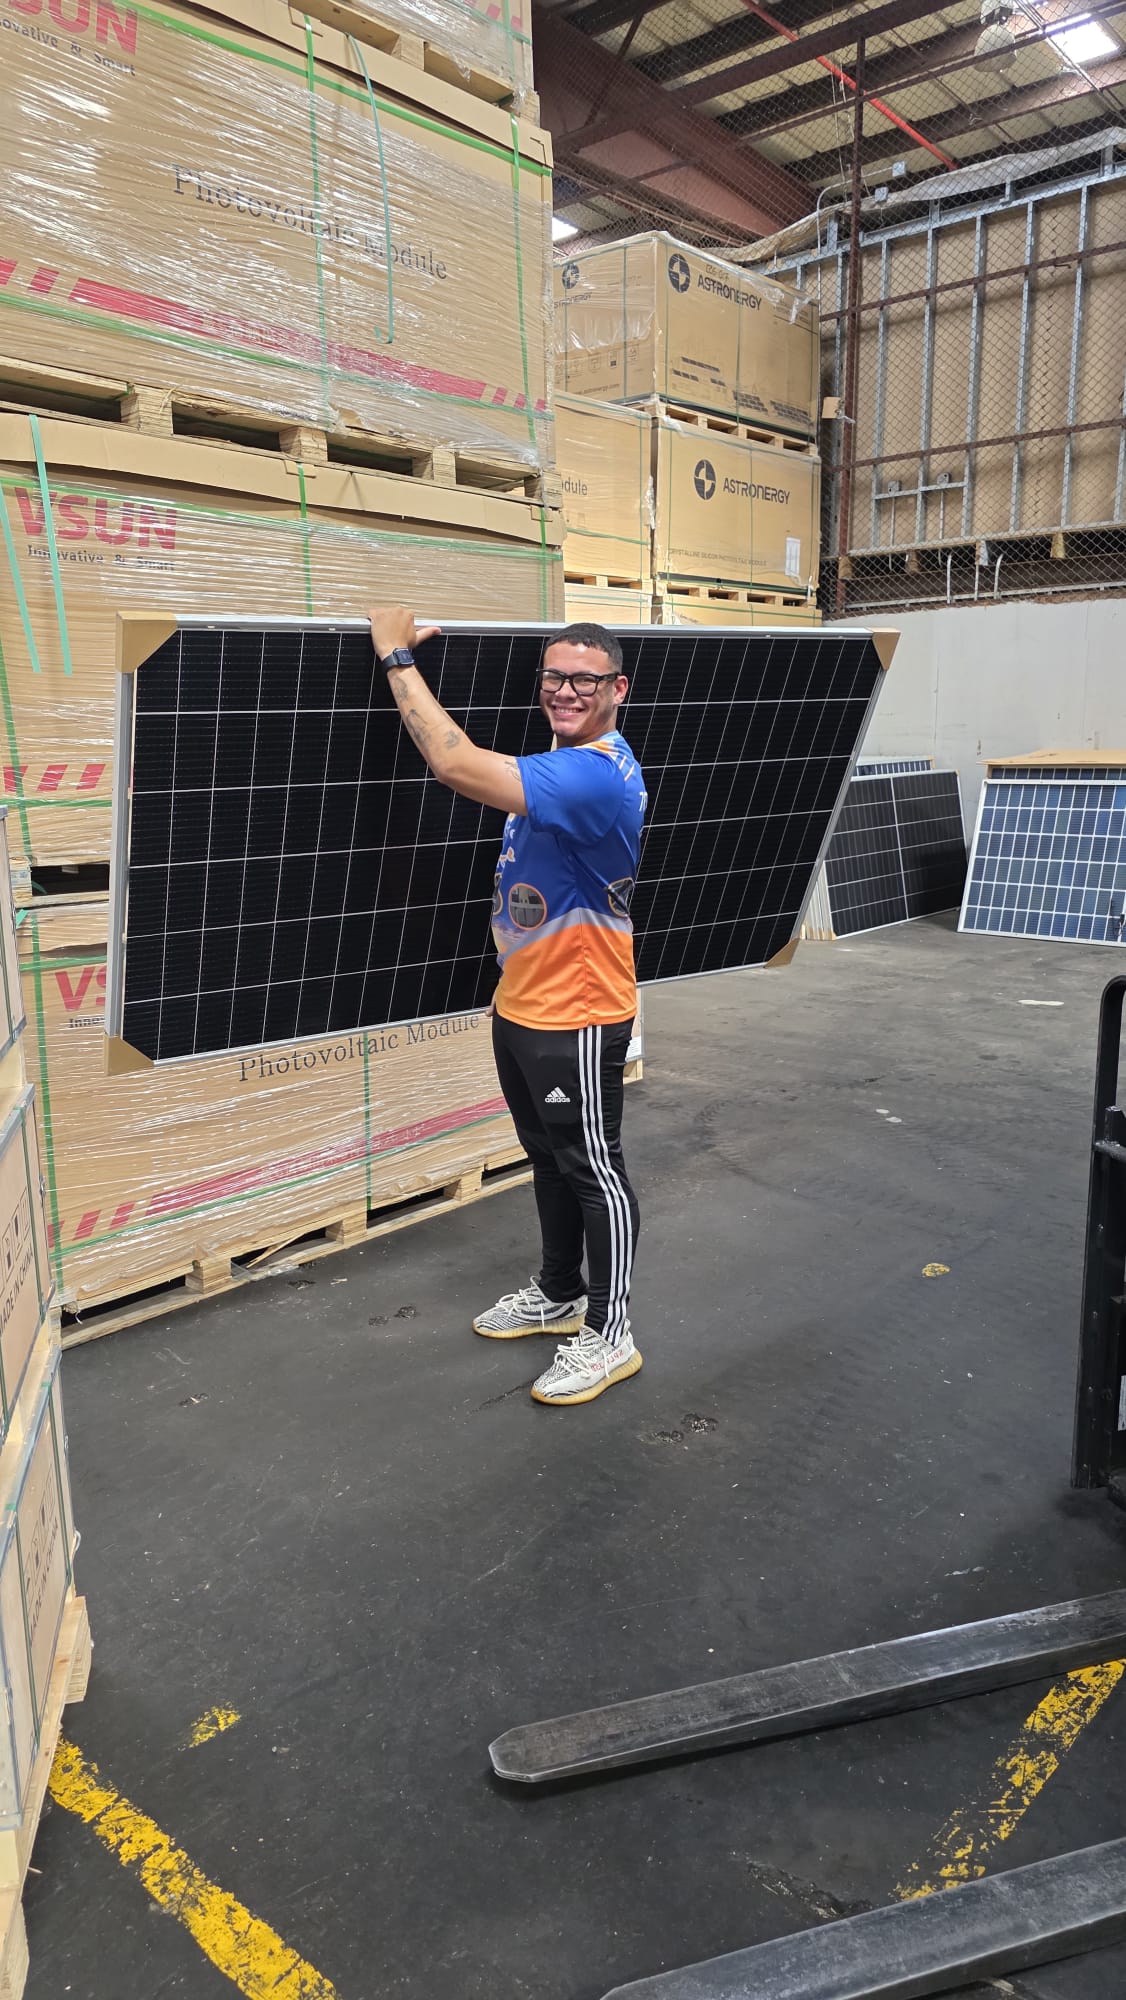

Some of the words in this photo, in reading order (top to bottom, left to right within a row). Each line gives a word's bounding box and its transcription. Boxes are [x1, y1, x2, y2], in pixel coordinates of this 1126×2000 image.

[172, 164, 354, 244] Photovoltaic
[363, 234, 447, 280] Module
[697, 274, 762, 310] ASTRONERGY
[723, 477, 790, 505] ASTRONERGY
[14, 487, 177, 550] VSUN
[27, 544, 104, 564] Innvative
[115, 554, 127, 565] &
[238, 1030, 399, 1082] Photovoltaic
[405, 1014, 480, 1046] Module
